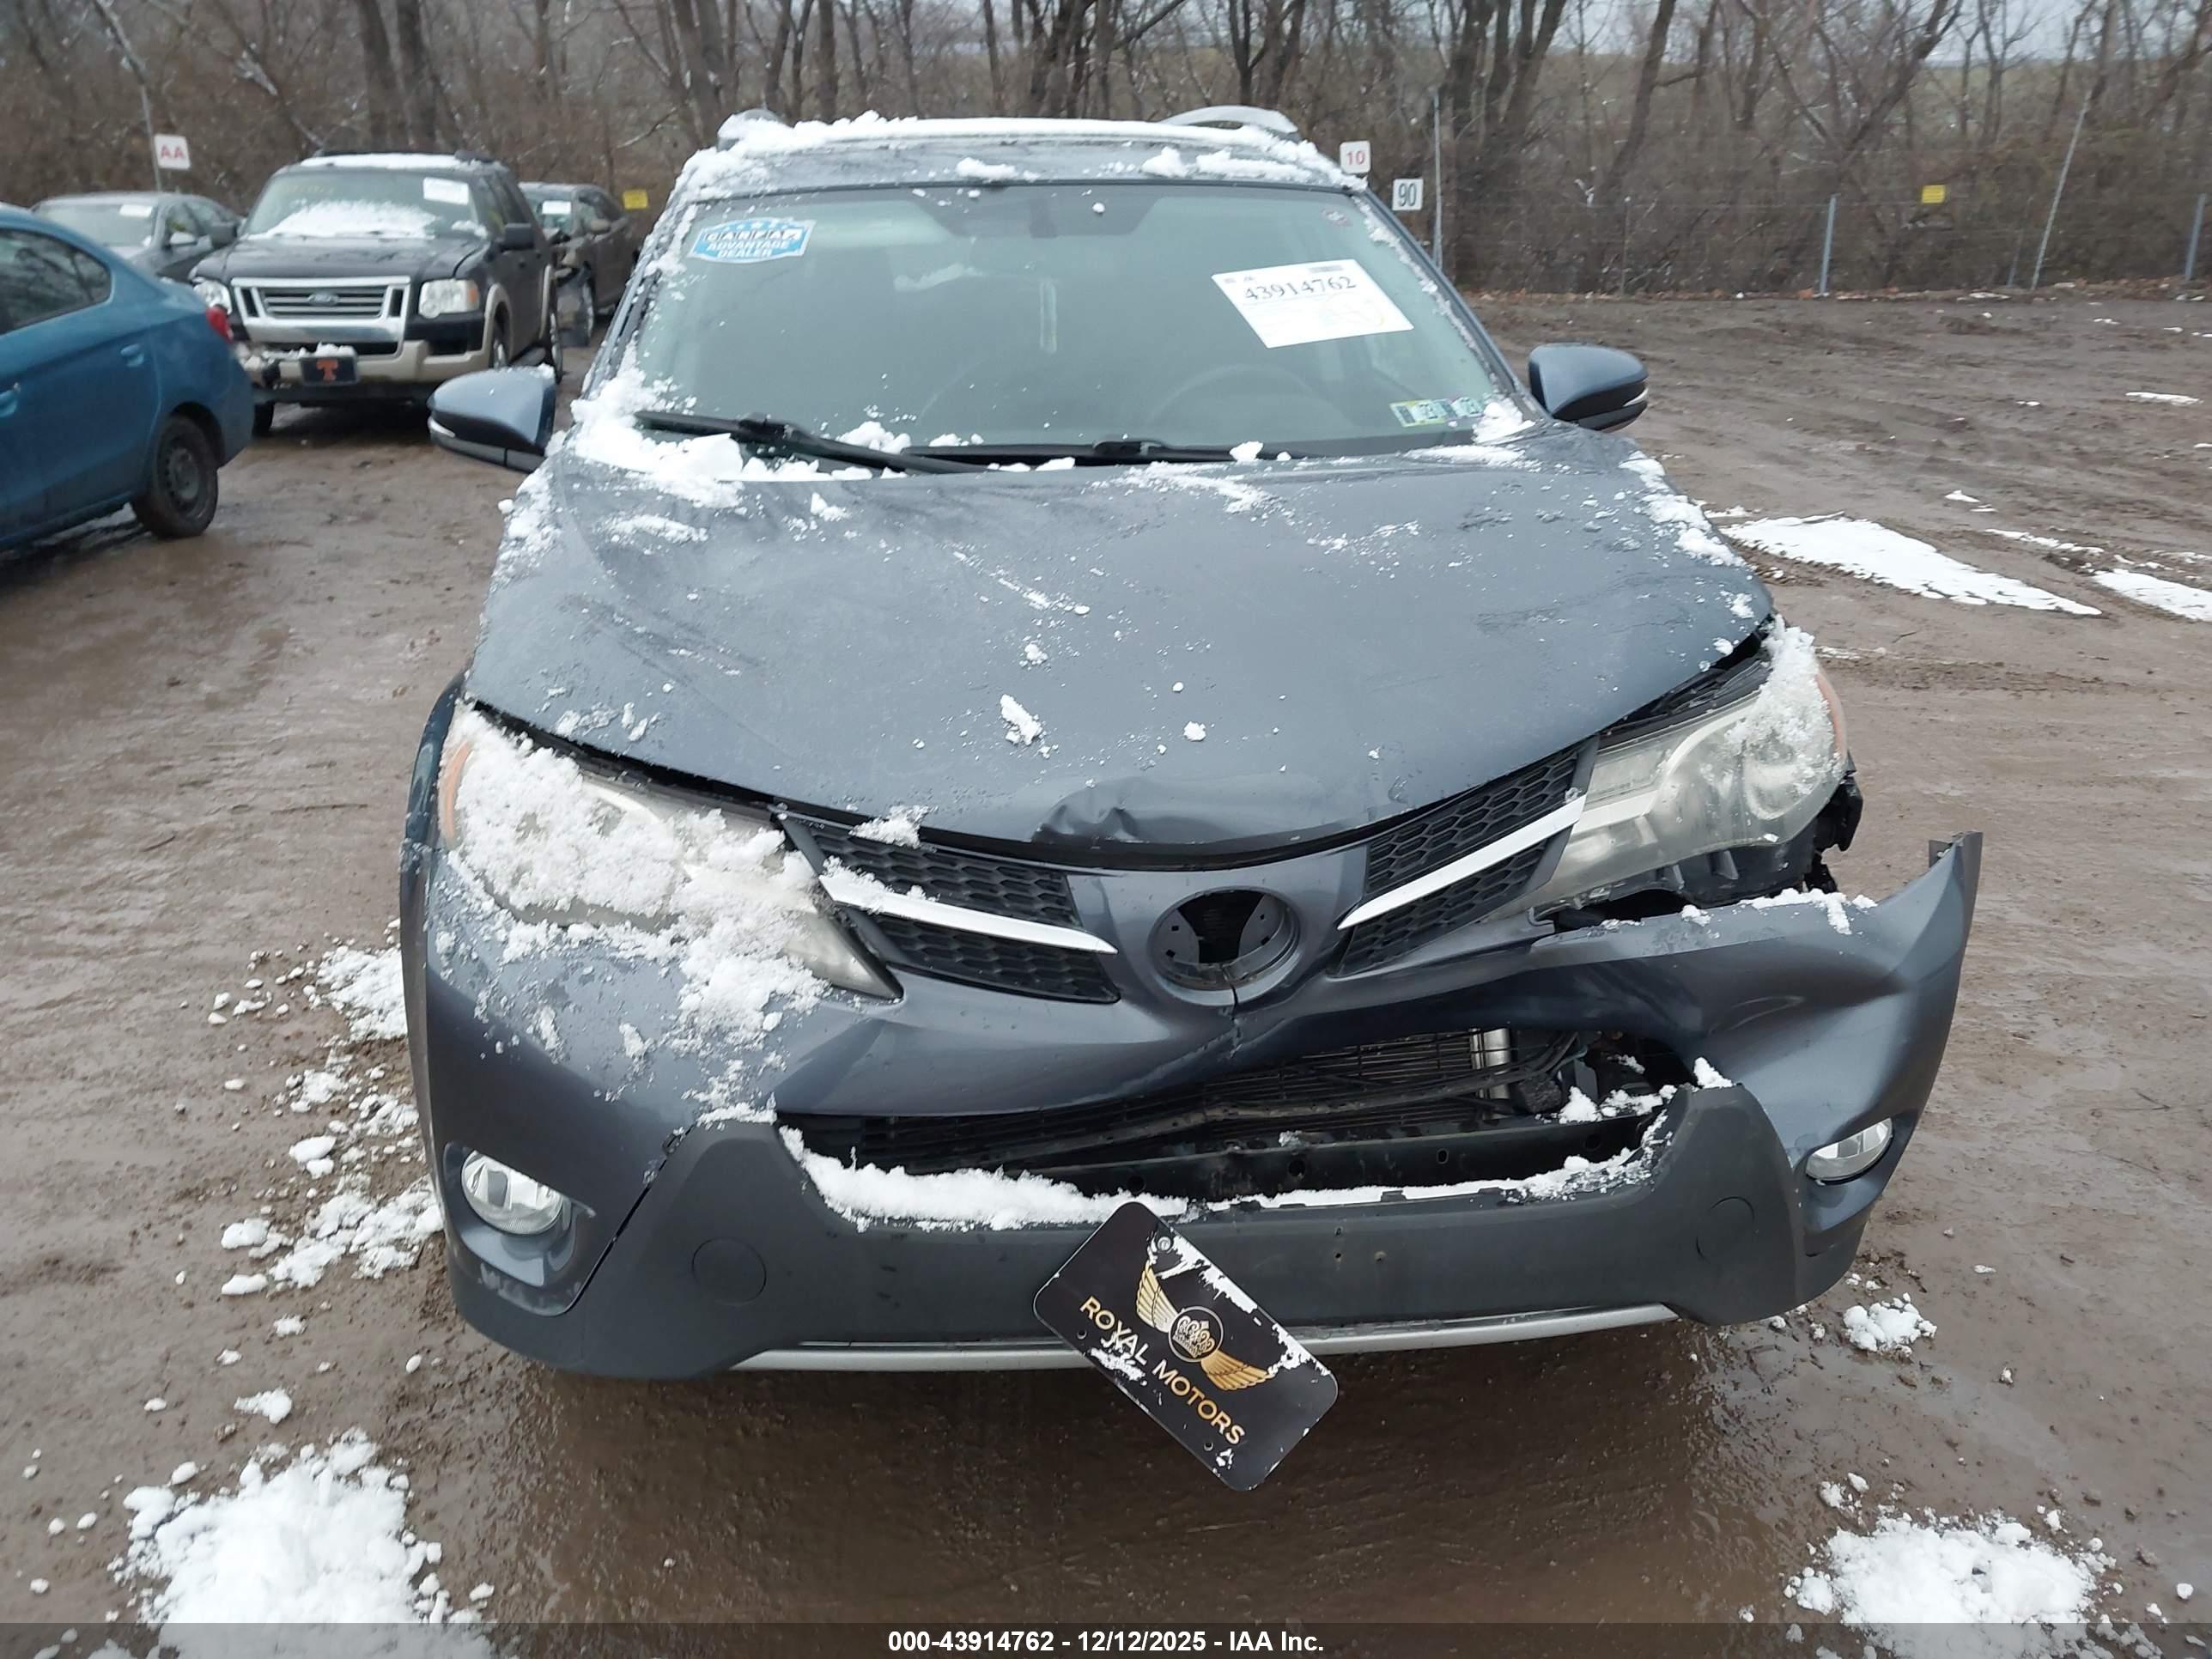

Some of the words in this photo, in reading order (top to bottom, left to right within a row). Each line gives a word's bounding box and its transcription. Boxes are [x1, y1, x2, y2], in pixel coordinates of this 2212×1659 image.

[161, 144, 185, 159] AA
[1346, 150, 1365, 165] 10
[1398, 183, 1418, 206] 90
[707, 239, 790, 251] ADVANTAGE
[716, 248, 773, 258] DEALER
[1244, 275, 1357, 301] 43914762
[1079, 1295, 1150, 1366] ROYAL
[1152, 1358, 1245, 1445] MOTORS
